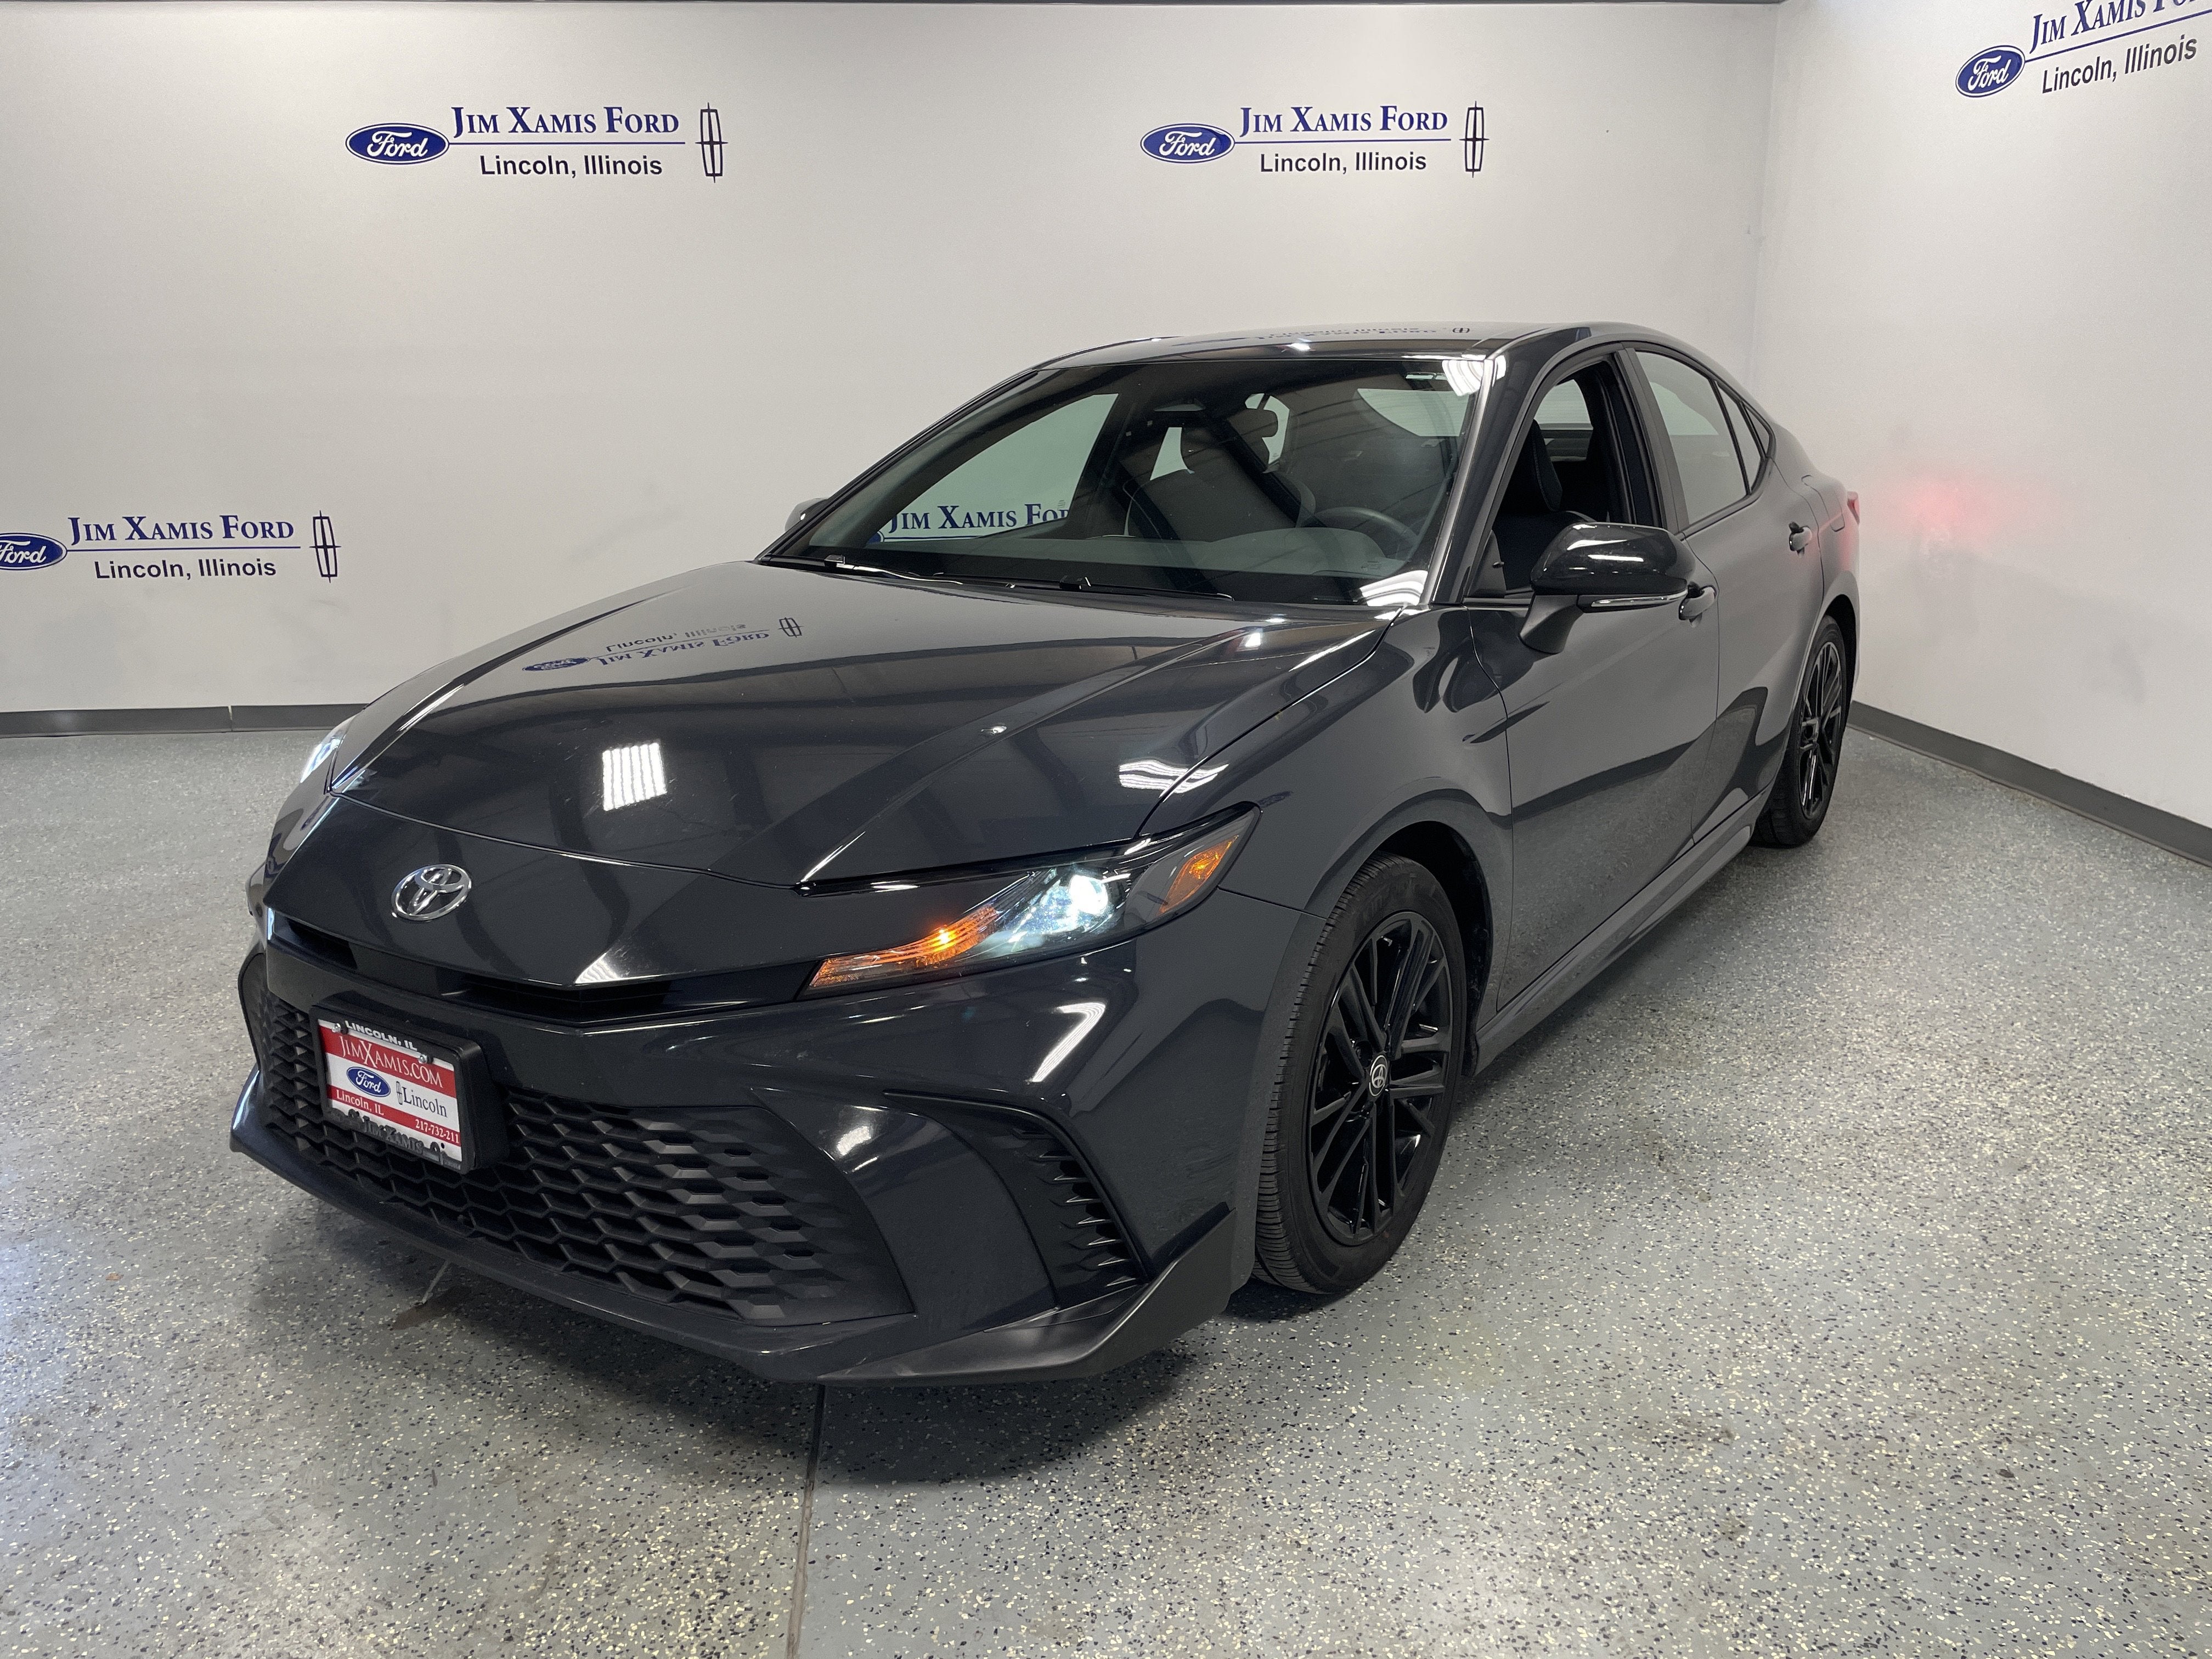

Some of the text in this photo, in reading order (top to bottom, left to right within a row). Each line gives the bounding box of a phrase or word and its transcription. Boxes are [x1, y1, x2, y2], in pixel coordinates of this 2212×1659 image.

[2042, 34, 2197, 93] Lincoln, Illinois
[452, 106, 679, 138] JIM XAMIS FORD
[1240, 105, 1448, 138] JIM XAMIS FORD
[480, 155, 663, 178] Lincoln, Illinois
[1261, 151, 1426, 174] Lincoln, Illinois
[68, 515, 294, 545] JIM XAMIS FORD
[94, 558, 276, 580] Lincoln, Illinois
[345, 1020, 418, 1052] LINCOLN, IL
[356, 1070, 382, 1093] Ford
[336, 1089, 385, 1116] Lincoln, IL
[402, 1086, 448, 1118] Lincoln
